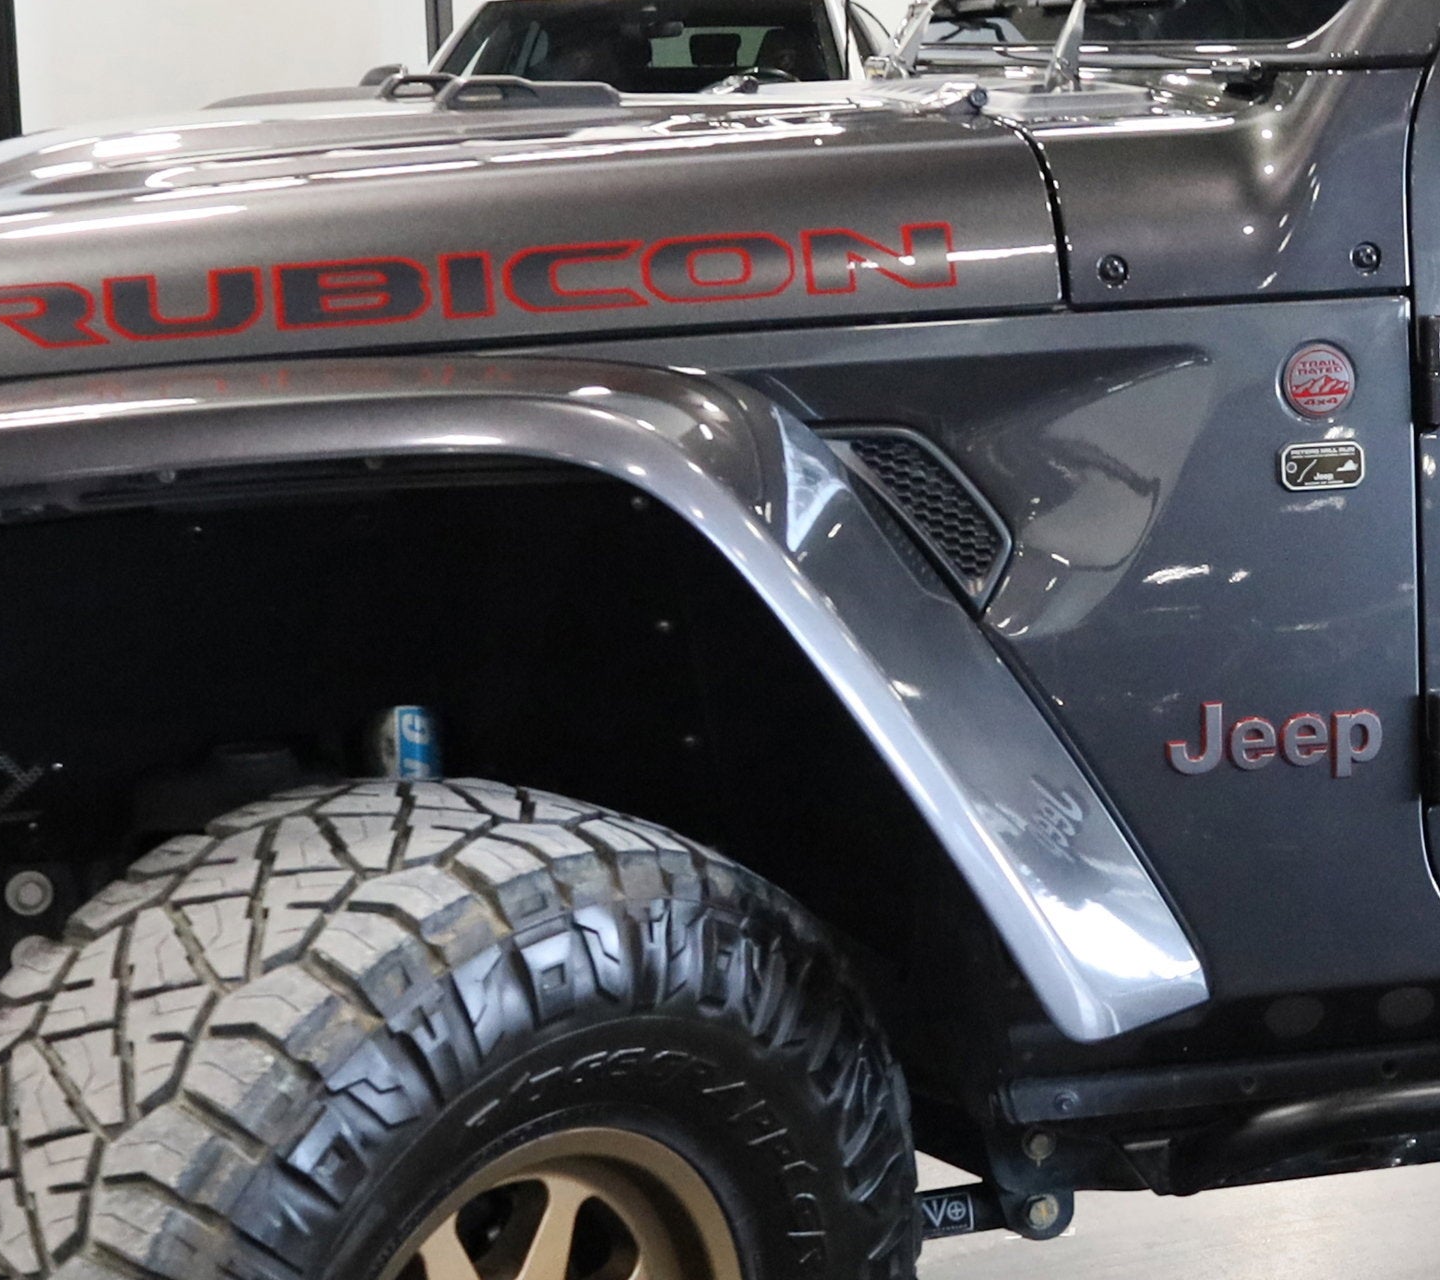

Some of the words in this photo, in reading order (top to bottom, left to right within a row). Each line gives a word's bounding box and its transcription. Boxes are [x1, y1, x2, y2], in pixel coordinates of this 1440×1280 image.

[1299, 359, 1341, 369] TRAIL
[1297, 366, 1344, 376] RATED
[1165, 700, 1384, 780] Jeep
